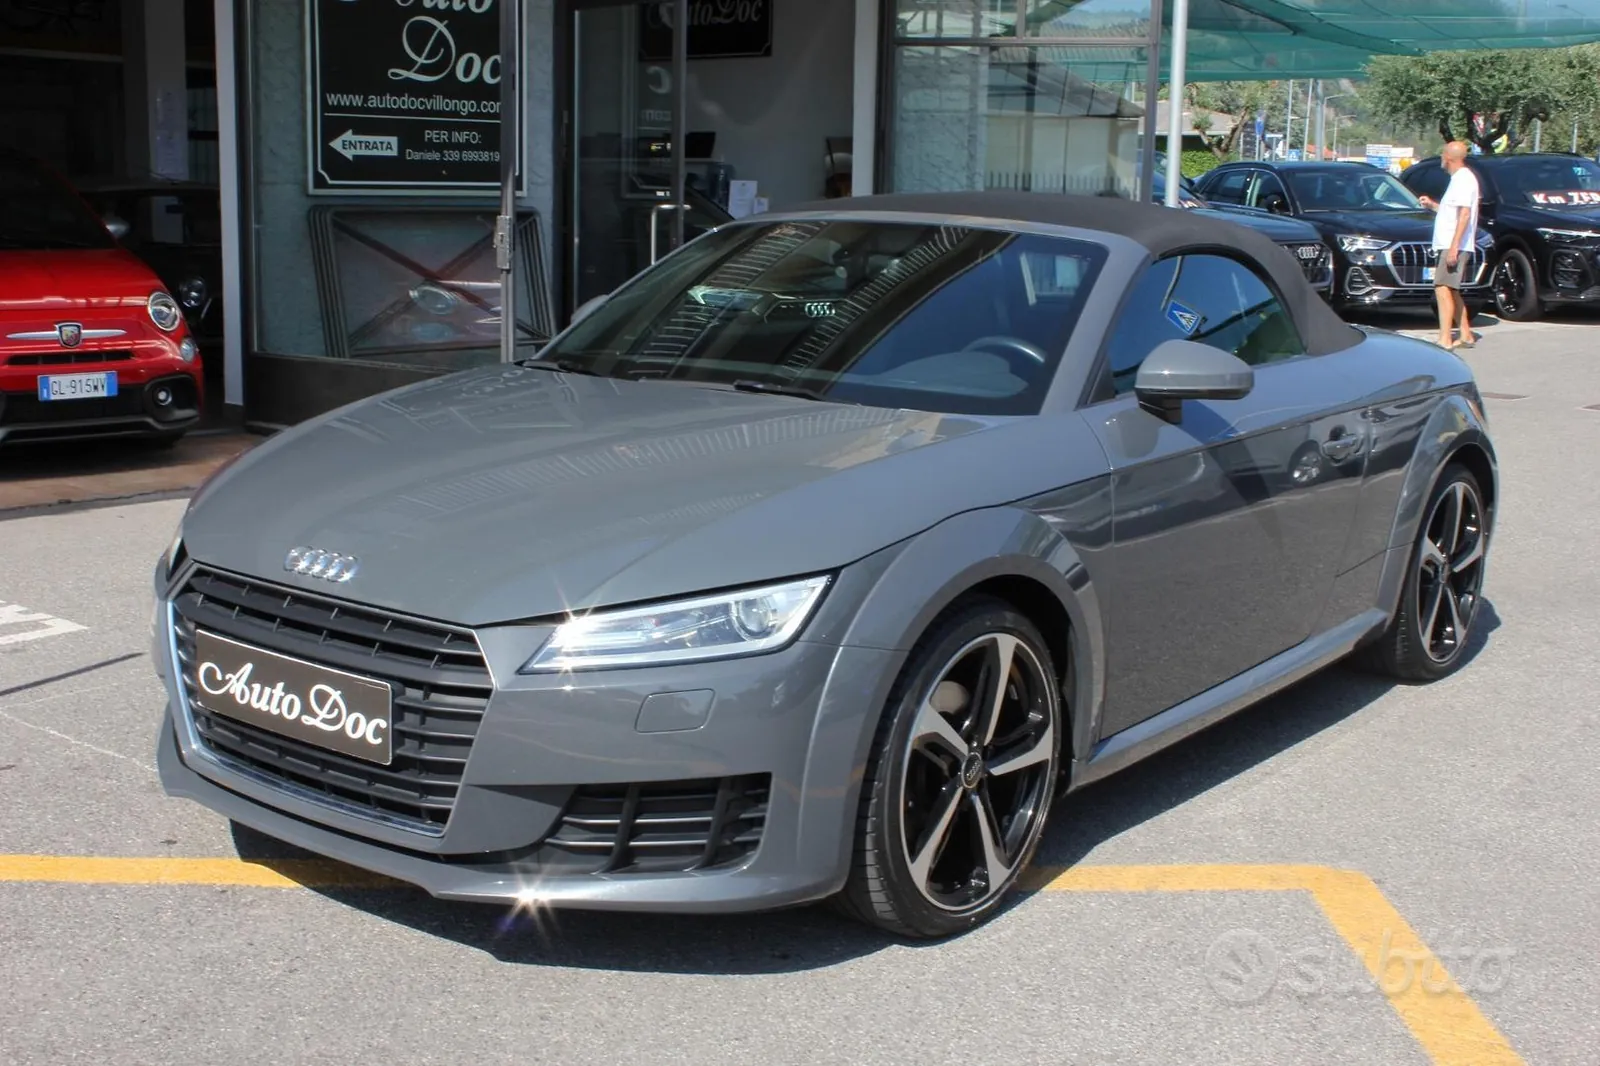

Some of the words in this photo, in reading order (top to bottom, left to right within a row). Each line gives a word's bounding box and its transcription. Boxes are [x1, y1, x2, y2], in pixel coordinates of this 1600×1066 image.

[387, 15, 501, 84] Doc
[424, 130, 449, 143] PER
[452, 131, 482, 144] INFO:
[342, 139, 394, 151] ENTRATA
[406, 148, 441, 161] Daniele
[443, 150, 460, 161] 339
[462, 151, 500, 162] 6993819
[1532, 192, 1566, 204] Km
[199, 661, 301, 720] Auto
[301, 683, 388, 745] Doc
